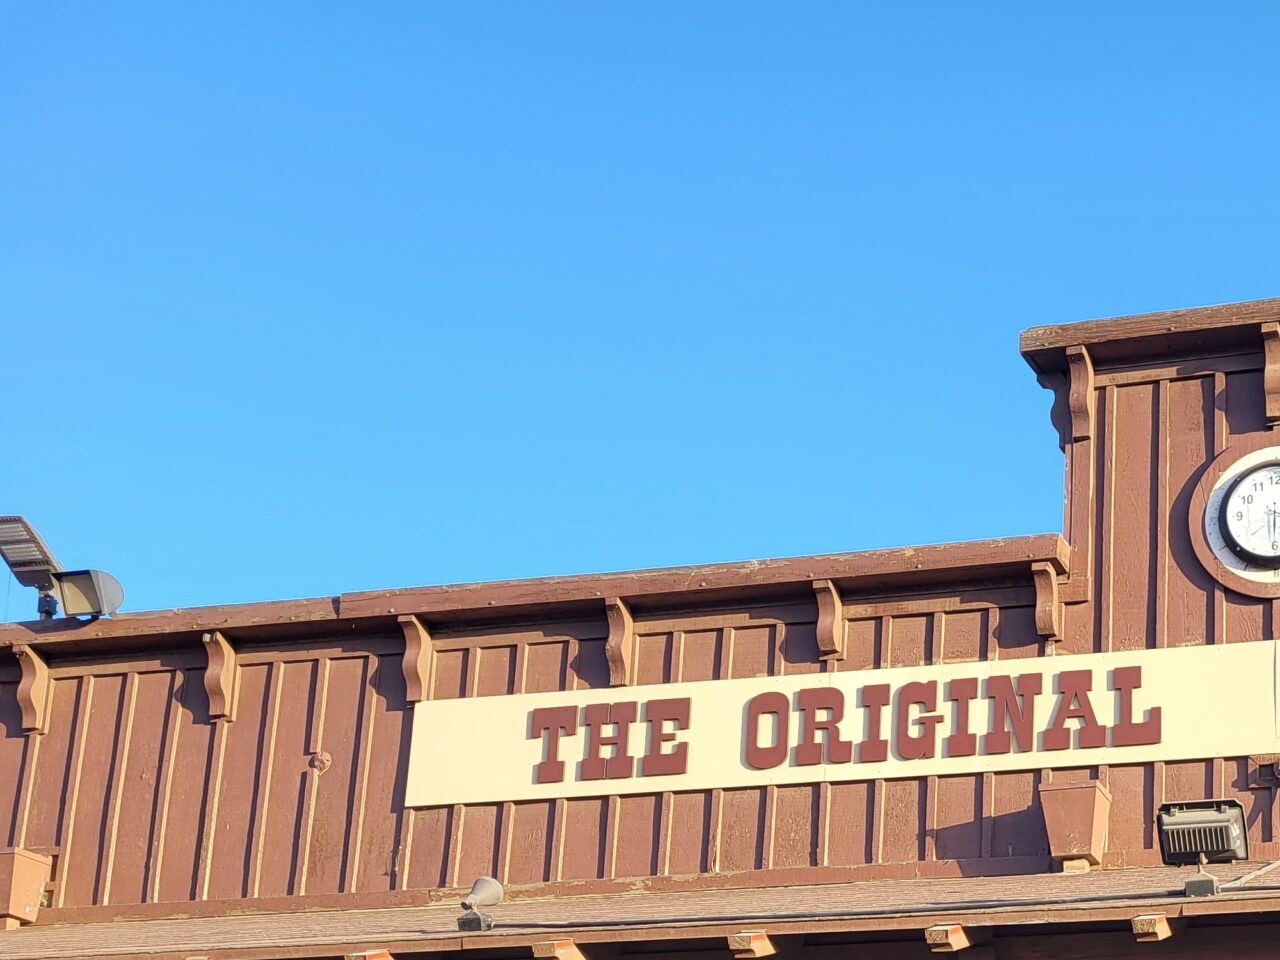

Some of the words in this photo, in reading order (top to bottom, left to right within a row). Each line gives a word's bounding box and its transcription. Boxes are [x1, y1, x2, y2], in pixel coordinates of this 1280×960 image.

[1252, 482, 1265, 493] 11
[1240, 494, 1254, 505] 10
[1235, 511, 1243, 522] 9
[1271, 540, 1279, 551] 6
[530, 697, 691, 784] THE
[743, 667, 1161, 770] ORIGINAL
